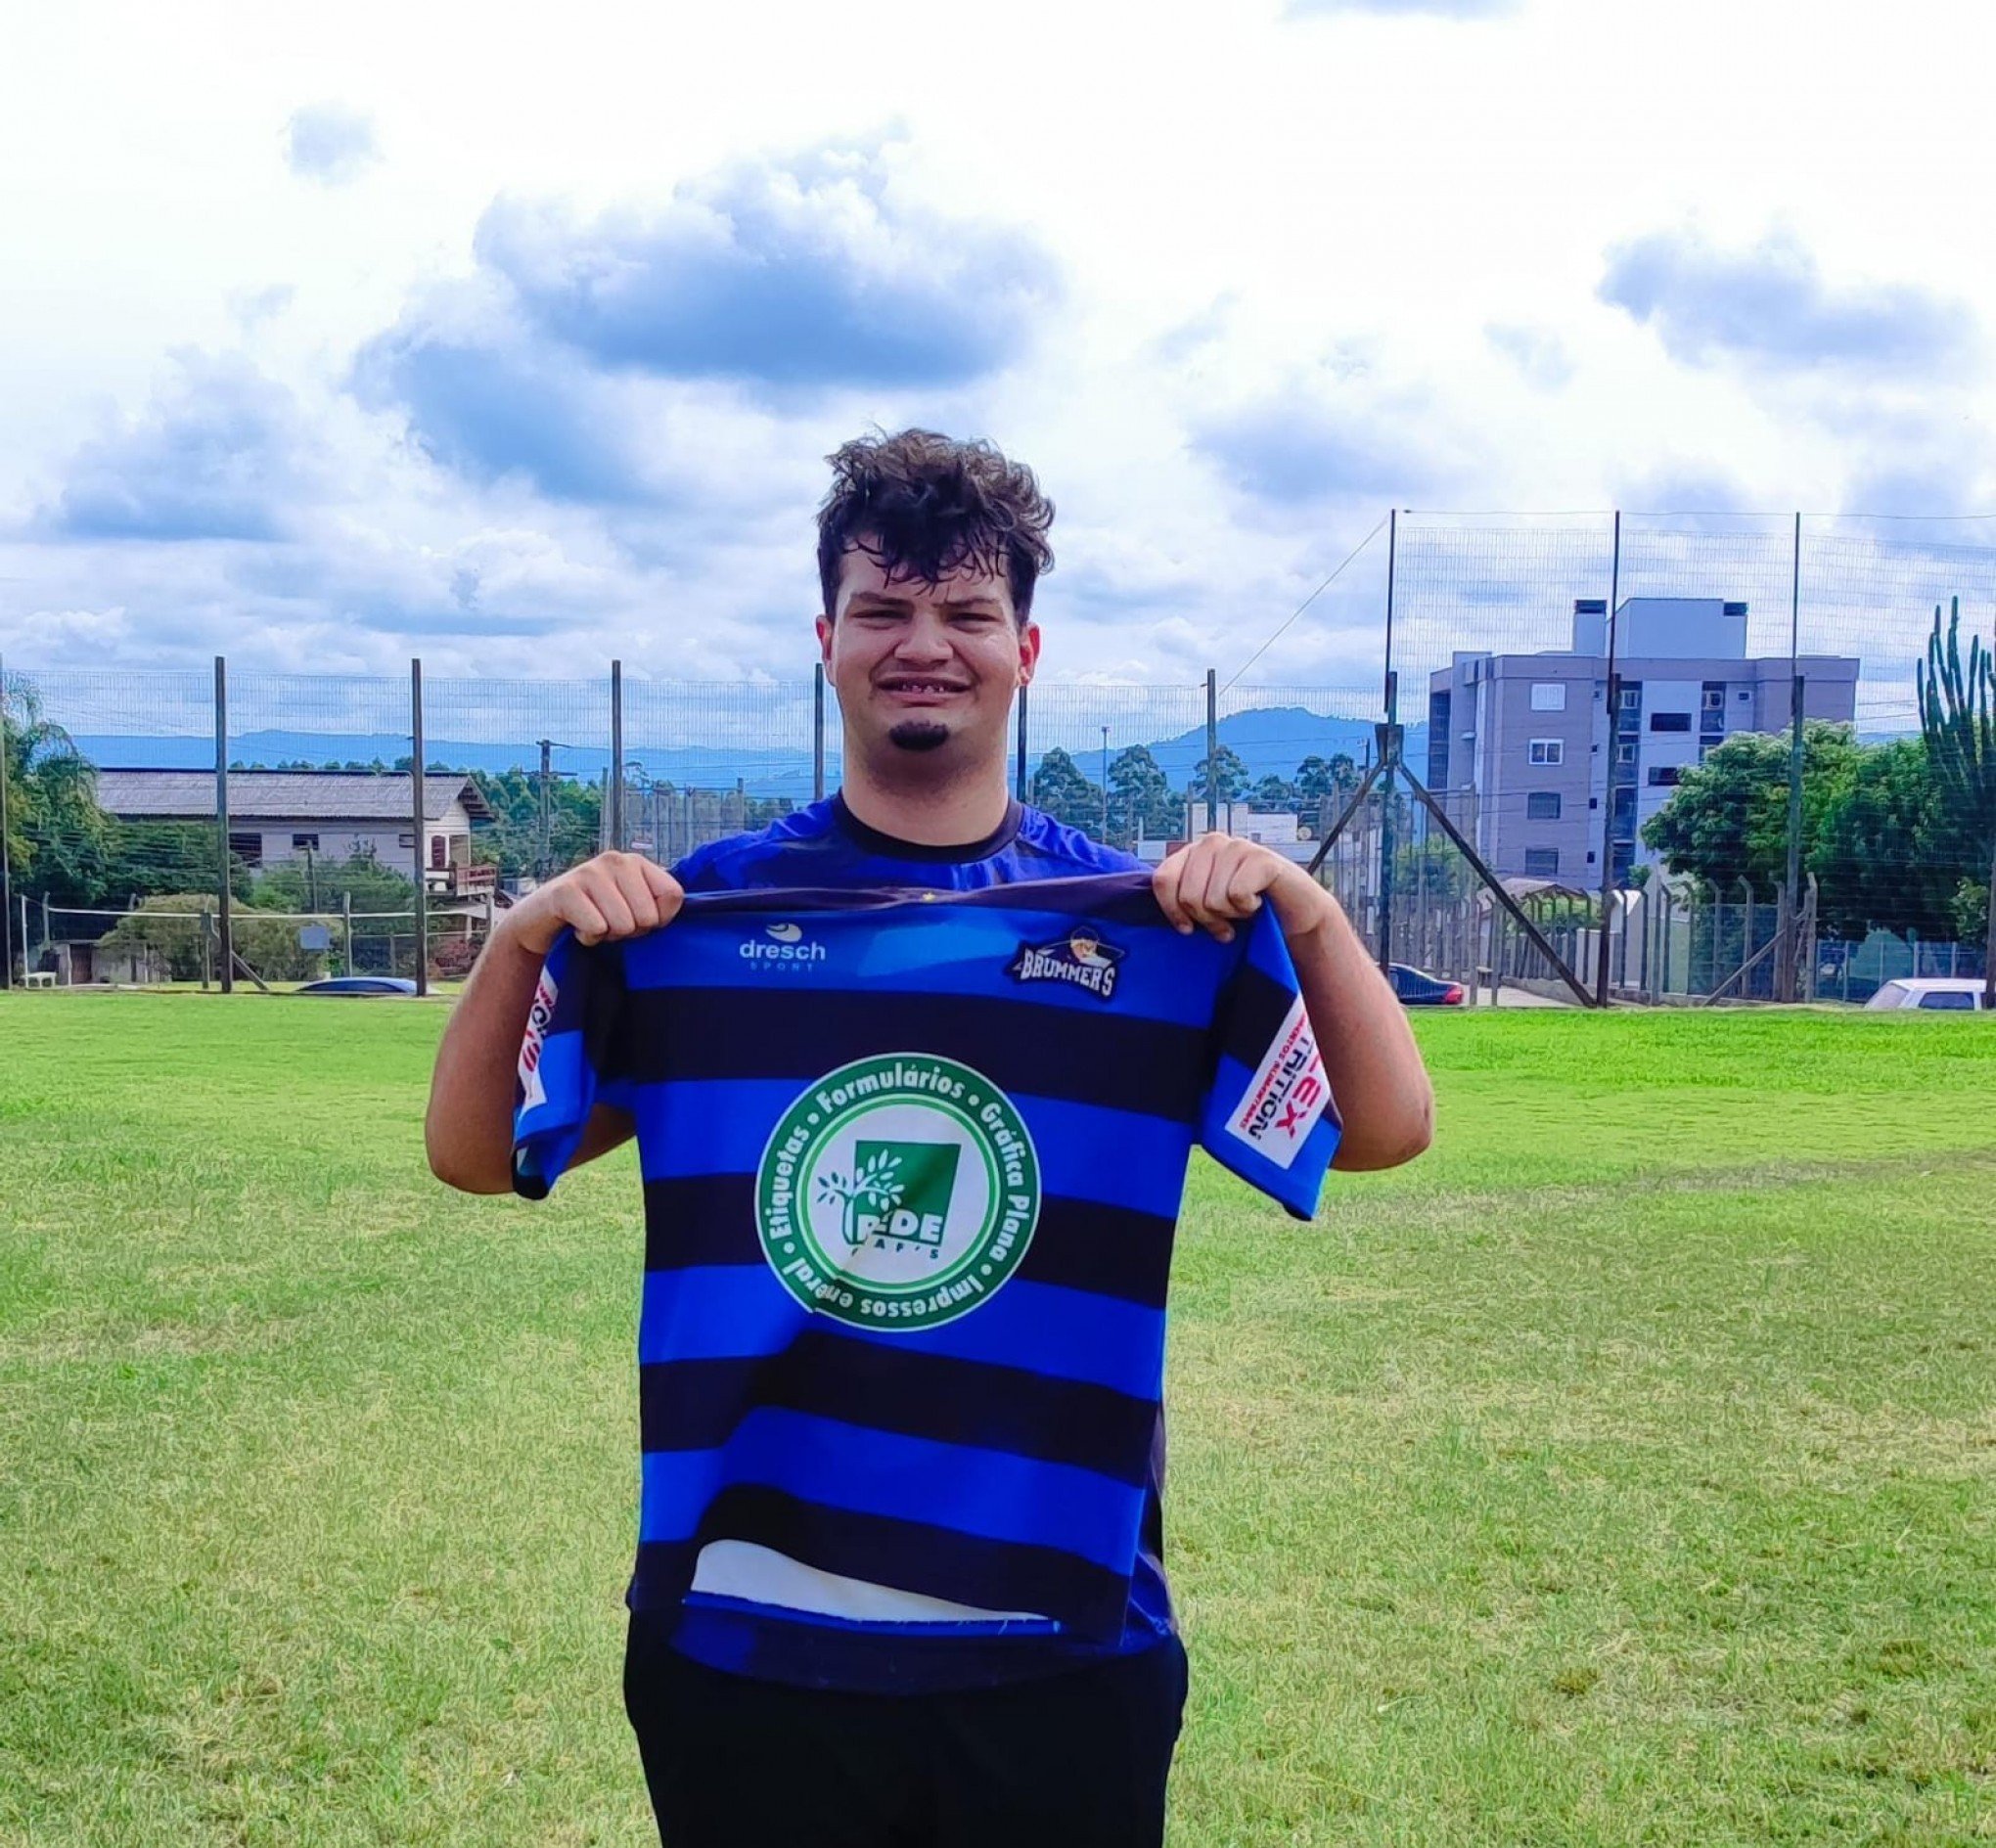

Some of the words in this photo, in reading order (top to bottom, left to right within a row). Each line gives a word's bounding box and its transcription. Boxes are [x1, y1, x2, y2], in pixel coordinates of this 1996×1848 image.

[738, 939, 826, 961] dresch
[749, 962, 814, 971] SPORT
[1018, 948, 1116, 997] BRUMMERS
[815, 1062, 966, 1114] Formulários
[979, 1102, 1026, 1187] Gráfica
[765, 1125, 810, 1240] Etiquetas
[989, 1194, 1030, 1262] Plana
[860, 1275, 984, 1318] Impressos
